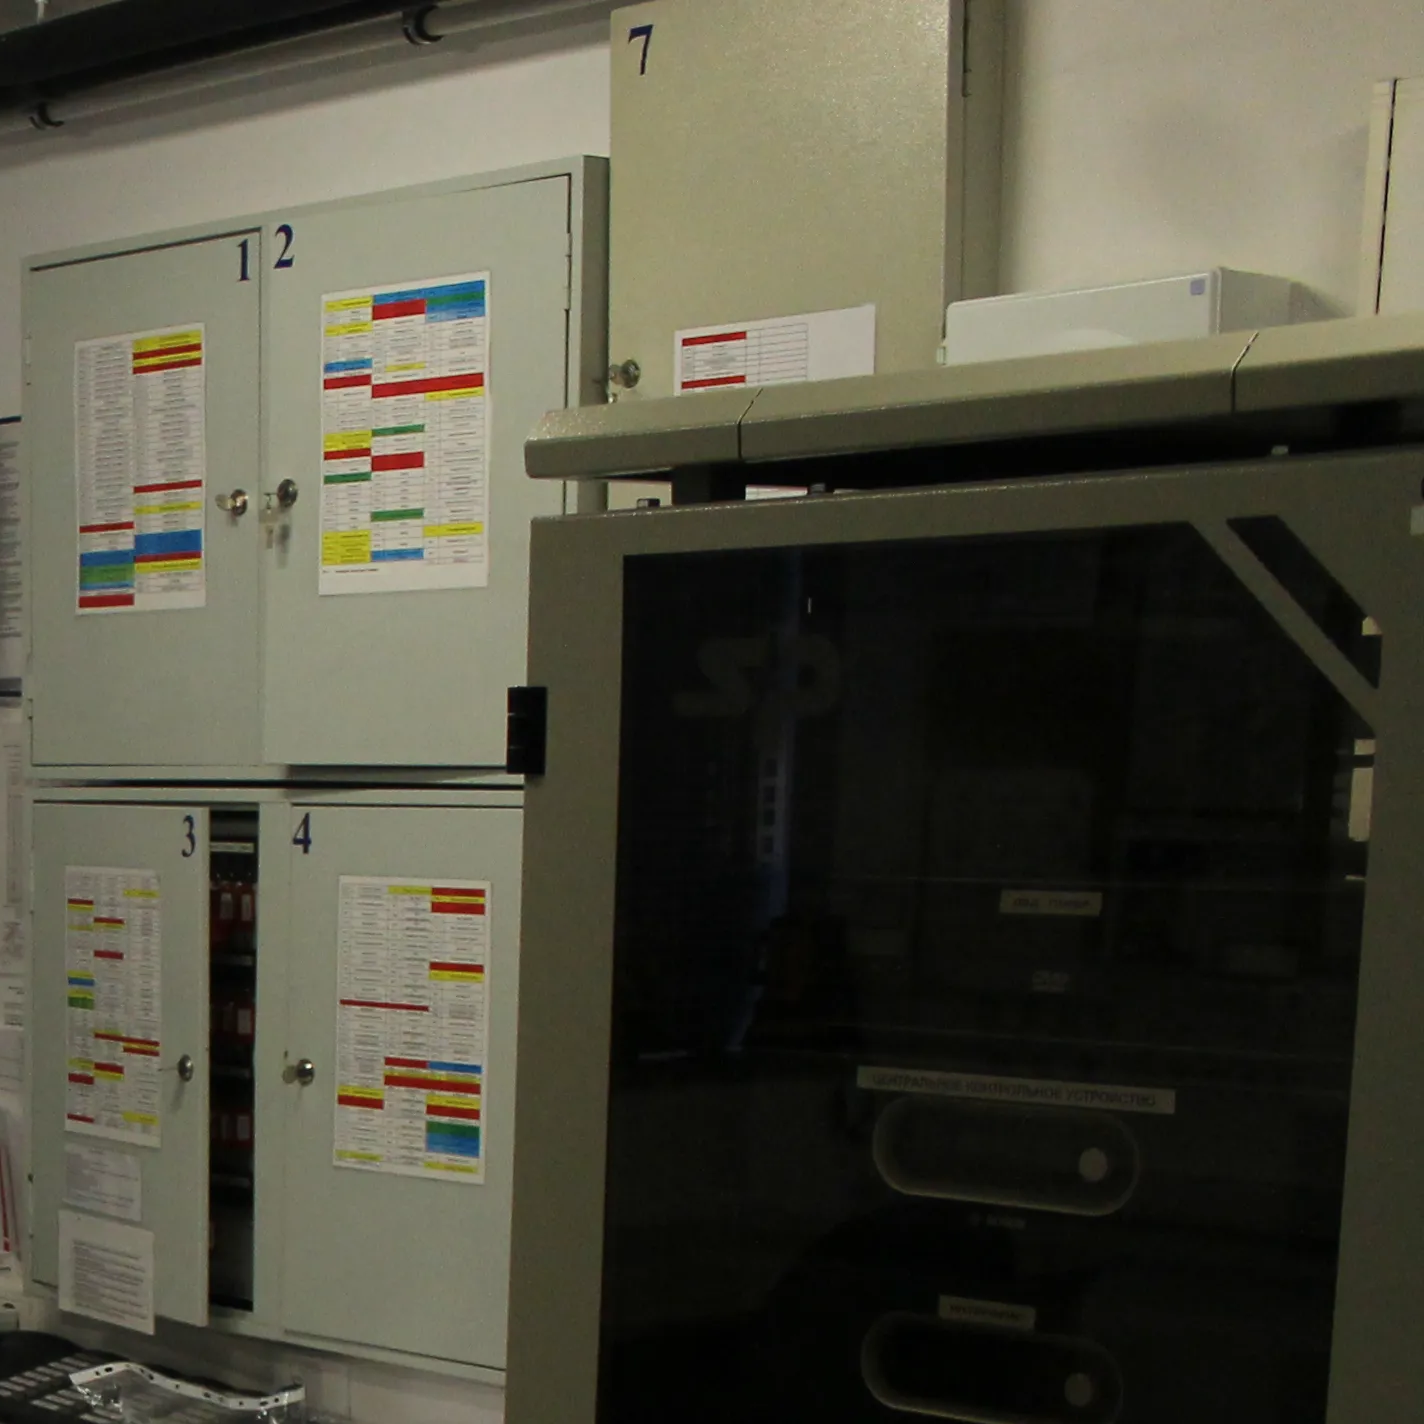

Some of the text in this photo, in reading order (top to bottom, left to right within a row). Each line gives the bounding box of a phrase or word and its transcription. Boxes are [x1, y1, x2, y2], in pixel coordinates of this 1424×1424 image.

[626, 24, 654, 76] 7
[235, 239, 252, 282] 1
[273, 224, 295, 269] 2
[180, 815, 197, 858] 3
[291, 812, 313, 855] 4
